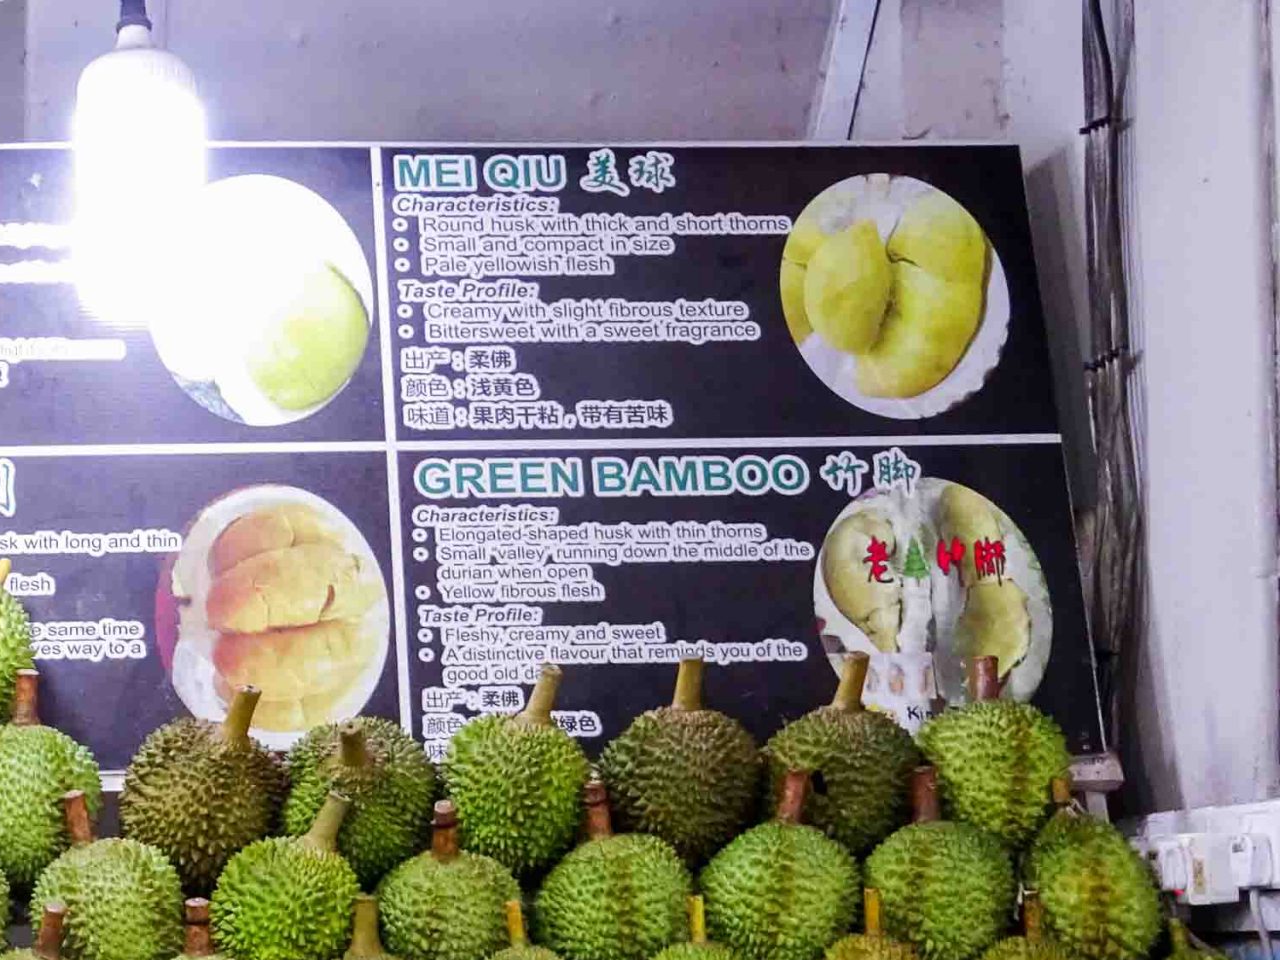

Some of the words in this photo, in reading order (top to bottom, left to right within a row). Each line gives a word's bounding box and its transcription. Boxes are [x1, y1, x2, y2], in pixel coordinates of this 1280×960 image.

[397, 157, 473, 188] MEI
[488, 157, 562, 189] QIU
[584, 153, 674, 196] 美球
[396, 197, 558, 215] Characteristics:
[422, 218, 485, 233] Round
[490, 217, 535, 233] husk
[543, 217, 579, 232] with
[585, 216, 629, 232] thick
[635, 216, 669, 231] and
[676, 215, 723, 231] short
[729, 215, 788, 231] thorns
[423, 237, 477, 253] Small
[482, 237, 518, 252] and
[524, 237, 605, 257] compact
[610, 236, 627, 252] in
[632, 236, 671, 252] size
[425, 257, 467, 273] Pale
[474, 256, 561, 277] yellowish
[567, 256, 611, 272] flesh
[400, 283, 455, 299] Taste
[462, 282, 536, 299] Profile:
[427, 304, 503, 323] Creamy
[507, 303, 546, 319] with
[552, 302, 604, 322] slight
[608, 302, 673, 319] fibrous
[679, 303, 745, 318] texture
[428, 323, 536, 340] Bittersweet
[541, 322, 580, 339] with
[586, 326, 596, 338] a
[603, 323, 660, 338] sweet
[665, 321, 756, 342] fragrance
[419, 462, 580, 495] GREEN
[596, 458, 806, 494] BAMBOO
[822, 450, 918, 497] 竹脚
[416, 507, 556, 523] Characteristics:
[24, 535, 59, 550] with
[65, 535, 102, 553] long
[108, 534, 140, 549] and
[147, 534, 178, 548] thin
[440, 526, 589, 545] Elongated-shaped
[595, 526, 632, 540] husk
[638, 526, 670, 540] with
[676, 525, 706, 539] thin
[712, 525, 762, 539] thorns
[440, 546, 487, 561] Small
[557, 546, 617, 562] running
[623, 545, 667, 558] down
[673, 544, 698, 558] the
[704, 543, 758, 558] middle
[763, 543, 780, 557] of
[784, 543, 809, 557] the
[441, 564, 491, 580] durian
[499, 564, 542, 580] when
[548, 566, 589, 583] open
[9, 577, 51, 592] flesh
[442, 584, 494, 599] Yellow
[501, 583, 557, 599] fibrous
[561, 583, 601, 598] flesh
[423, 609, 469, 623] Taste
[475, 608, 539, 623] Profile:
[47, 625, 96, 637] same
[103, 621, 140, 636] time
[445, 627, 503, 645] Fleshy,
[508, 629, 569, 646] creamy
[576, 626, 606, 641] and
[612, 626, 662, 641] sweet
[66, 643, 101, 660] way
[107, 642, 126, 655] to
[130, 644, 141, 655] a
[446, 647, 459, 661] A
[463, 646, 545, 662] distinctive
[550, 646, 605, 661] flavour
[611, 645, 642, 660] that
[648, 643, 715, 659] reminds
[720, 646, 750, 664] you
[756, 643, 773, 658] of
[777, 642, 802, 657] the
[447, 669, 488, 684] good
[494, 668, 518, 681] old
